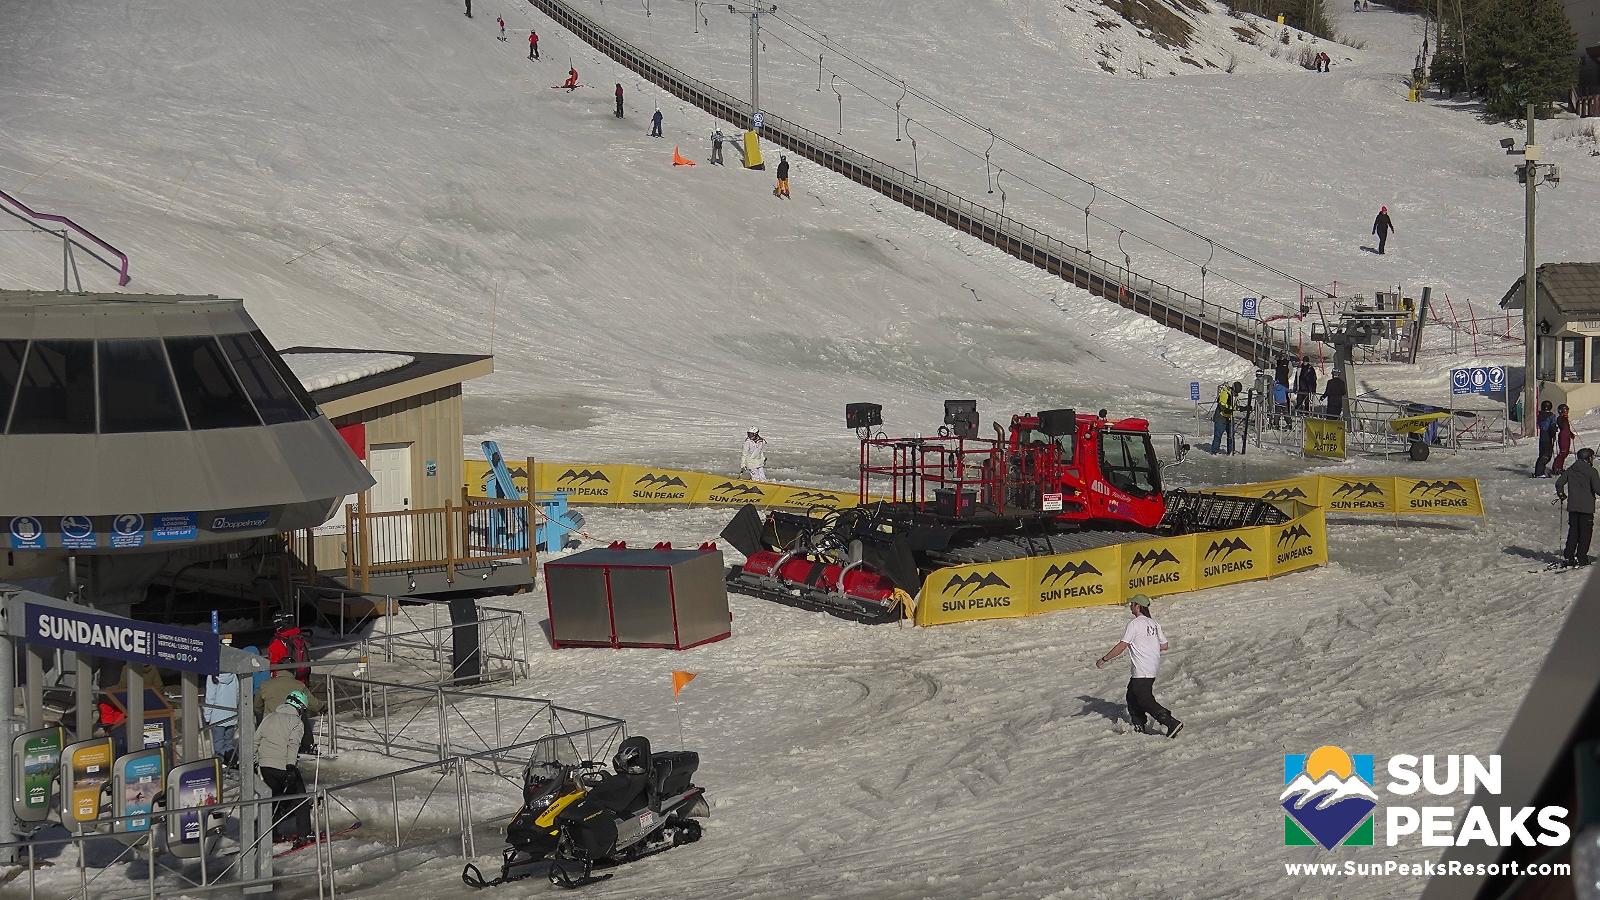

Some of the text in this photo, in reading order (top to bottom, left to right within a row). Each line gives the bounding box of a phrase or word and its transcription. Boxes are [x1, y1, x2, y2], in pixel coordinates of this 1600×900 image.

[1409, 420, 1431, 428] PEAK
[1314, 431, 1337, 441] VILLAGE
[578, 487, 609, 496] PEAKS
[632, 489, 685, 499] SUN PEAKS
[708, 494, 730, 503] SUN
[1410, 498, 1468, 508] SUN PEAKS
[1330, 501, 1385, 509] SUN PEAKS
[222, 518, 266, 529] Doppelmayr
[1277, 545, 1313, 564] SUN PEAKS
[1203, 559, 1253, 578] SUN PEAKS
[1128, 571, 1180, 589] SUN PEAKS
[1040, 584, 1104, 602] SUN PEAKS
[942, 596, 1011, 612] SUN PEAKS
[38, 614, 146, 655] SUNDANCE
